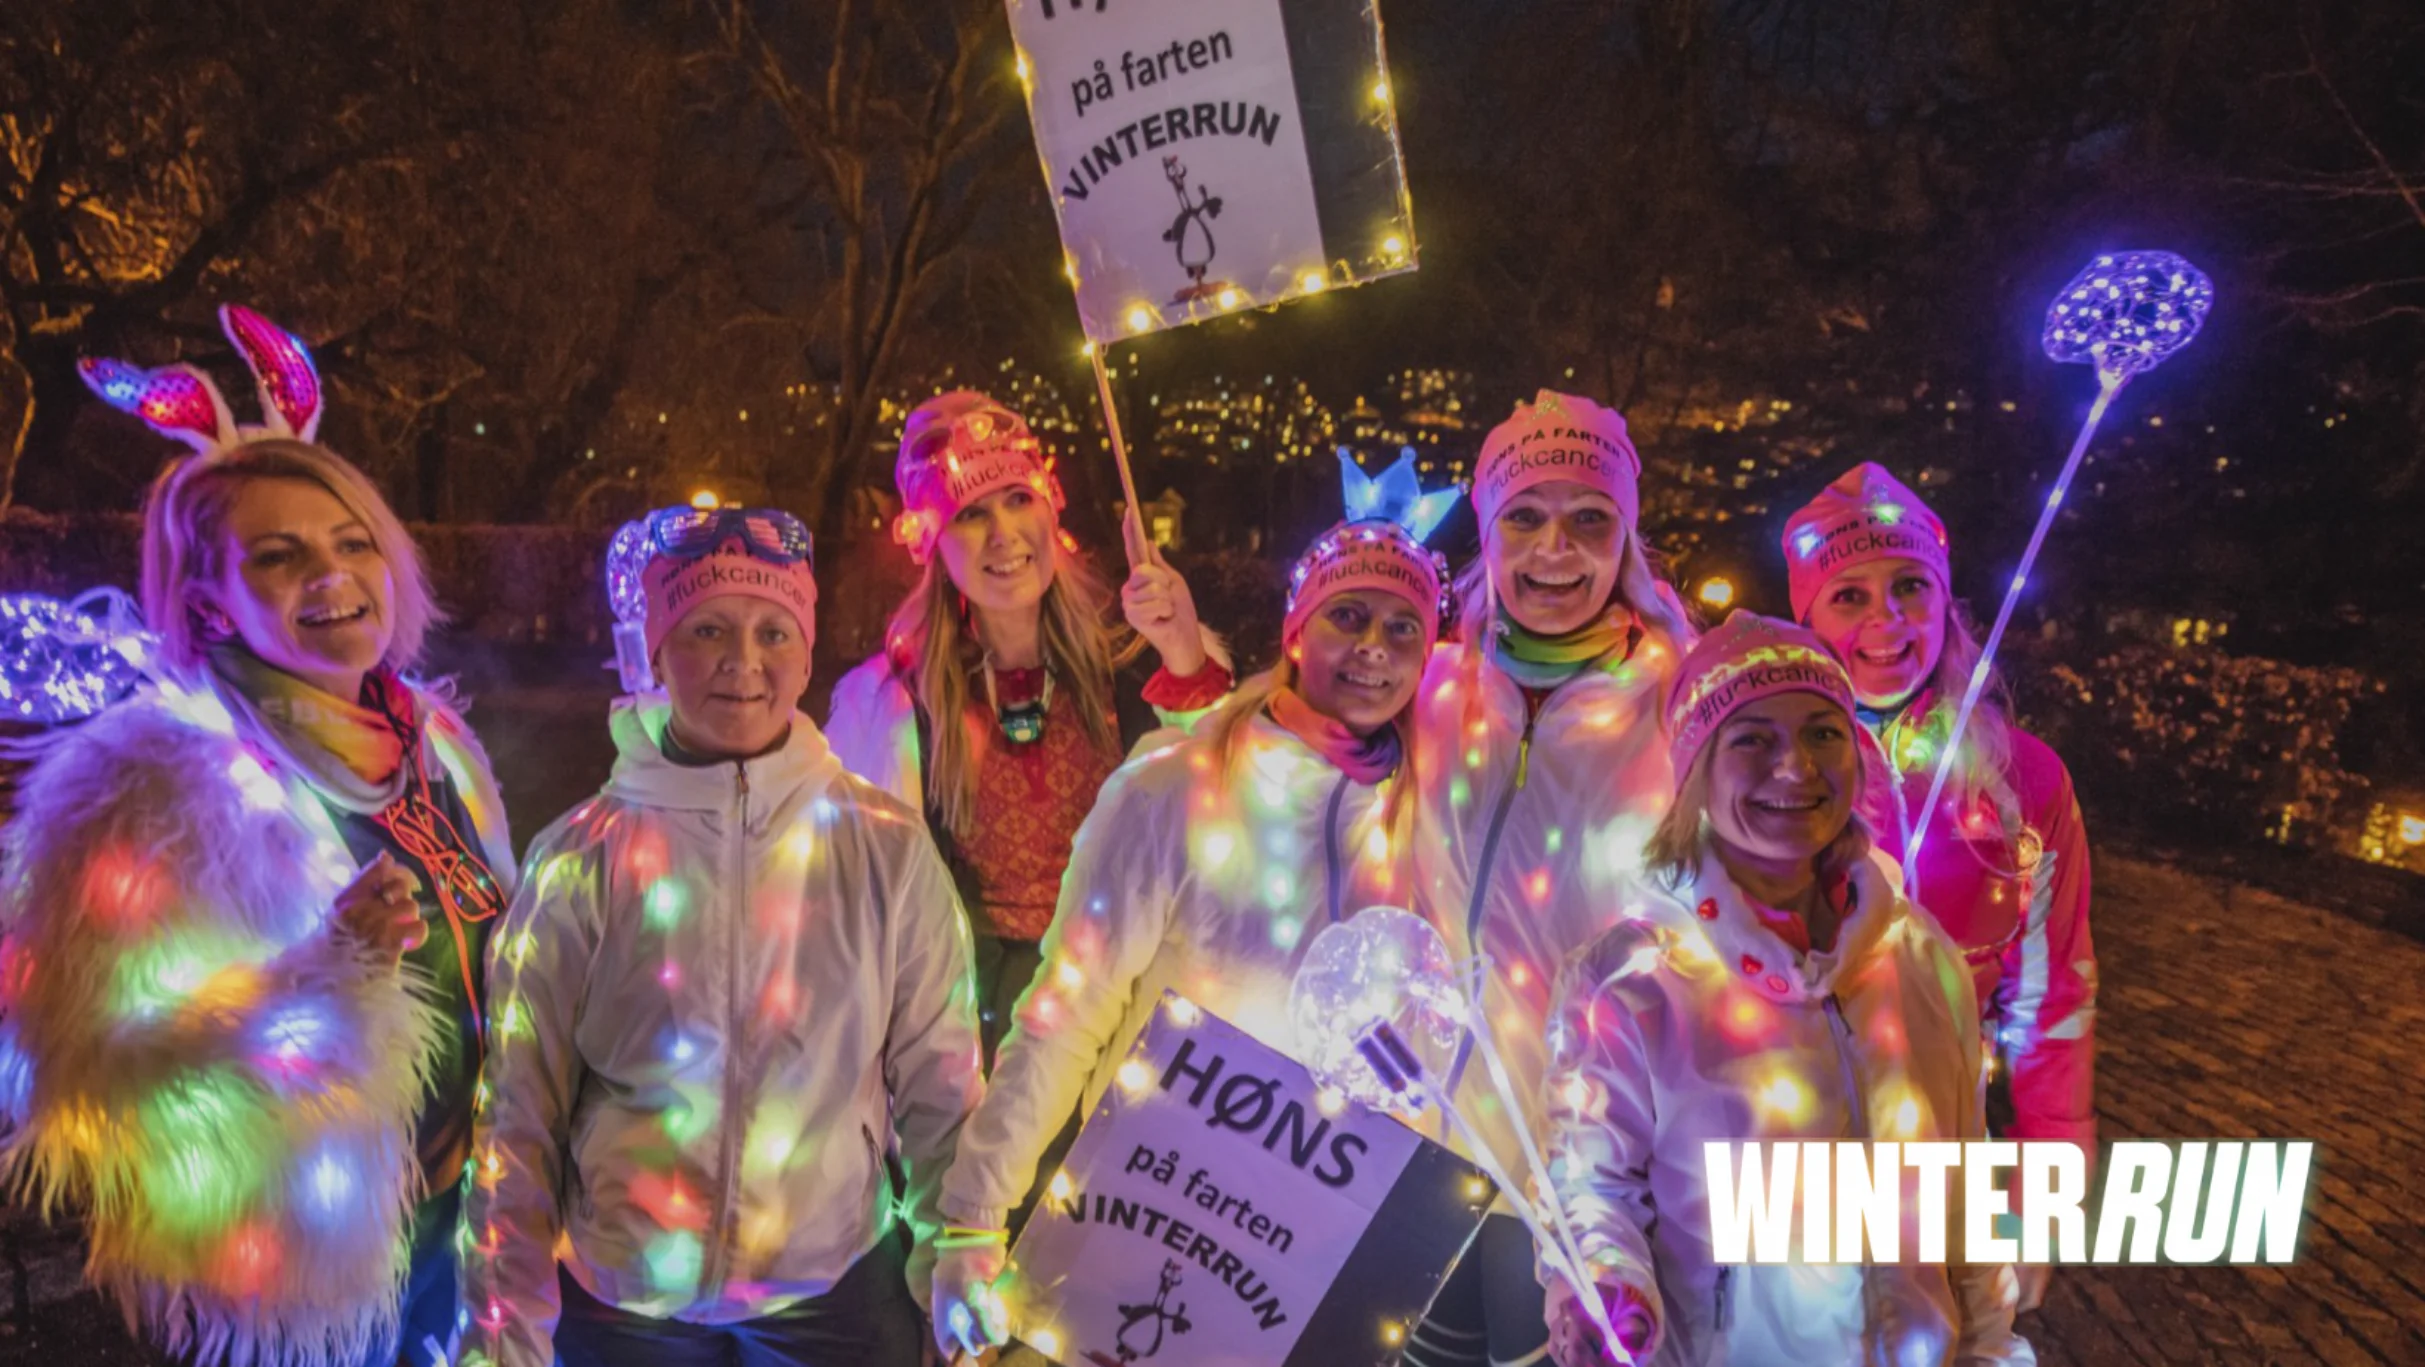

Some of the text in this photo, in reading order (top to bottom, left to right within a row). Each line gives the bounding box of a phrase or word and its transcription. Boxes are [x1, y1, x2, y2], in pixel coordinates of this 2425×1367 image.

[1070, 29, 1234, 117] på farten
[1062, 100, 1281, 203] VINTERRUN
[1490, 447, 1617, 499] fuckcance
[1157, 1037, 1369, 1190] HØNS
[1124, 1143, 1295, 1254] på farten
[1062, 1192, 1288, 1332] VINTERRUN
